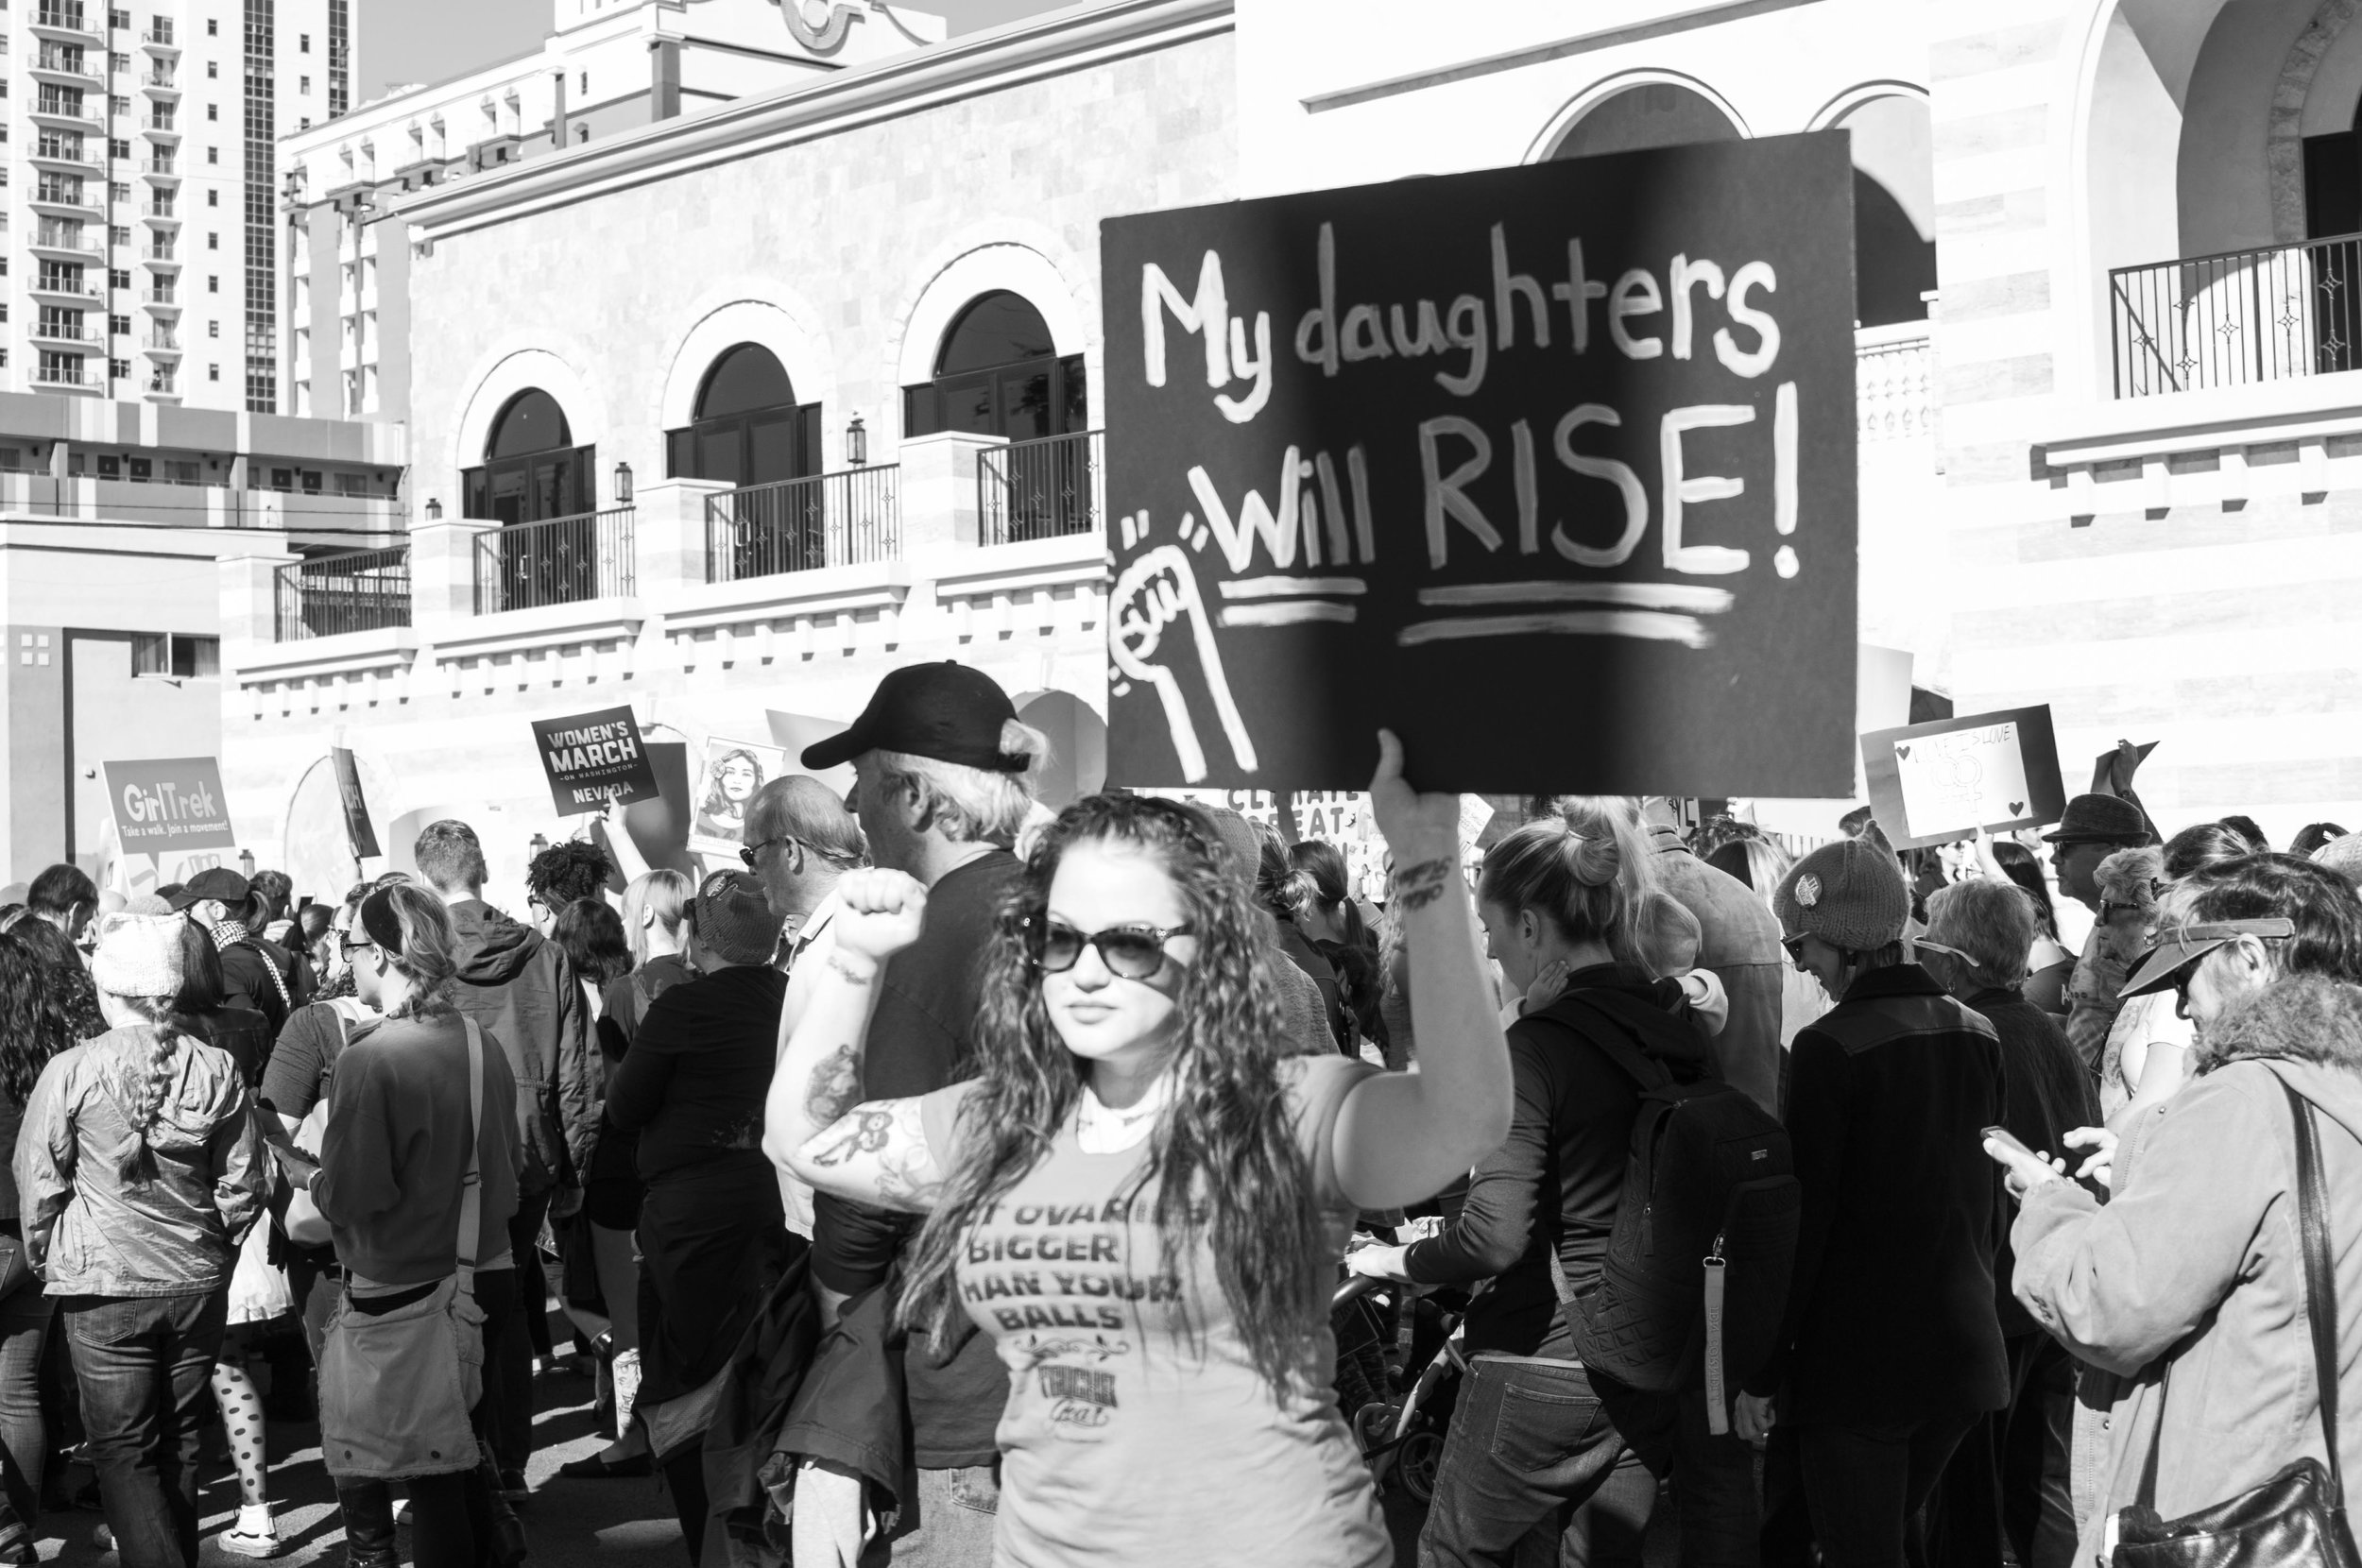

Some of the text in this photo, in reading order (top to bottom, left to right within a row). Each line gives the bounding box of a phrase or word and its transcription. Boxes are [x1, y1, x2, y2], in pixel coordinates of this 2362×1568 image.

[1142, 221, 1780, 423] My daughters
[1188, 381, 1801, 578] Will RISE!
[547, 721, 628, 748] WOMEN'S
[1982, 724, 2011, 744] LOVE
[549, 737, 638, 773] MARCH
[123, 780, 217, 822] GirlTrek
[573, 781, 634, 803] NEVADA
[121, 825, 140, 837] Take
[142, 827, 146, 836] a
[146, 823, 167, 835] walk.
[183, 825, 188, 833] a
[190, 819, 230, 833] movement!
[969, 1233, 1119, 1265] BIGGER
[962, 1270, 1182, 1303] HAN YOUR
[995, 1303, 1123, 1332] BALLS
